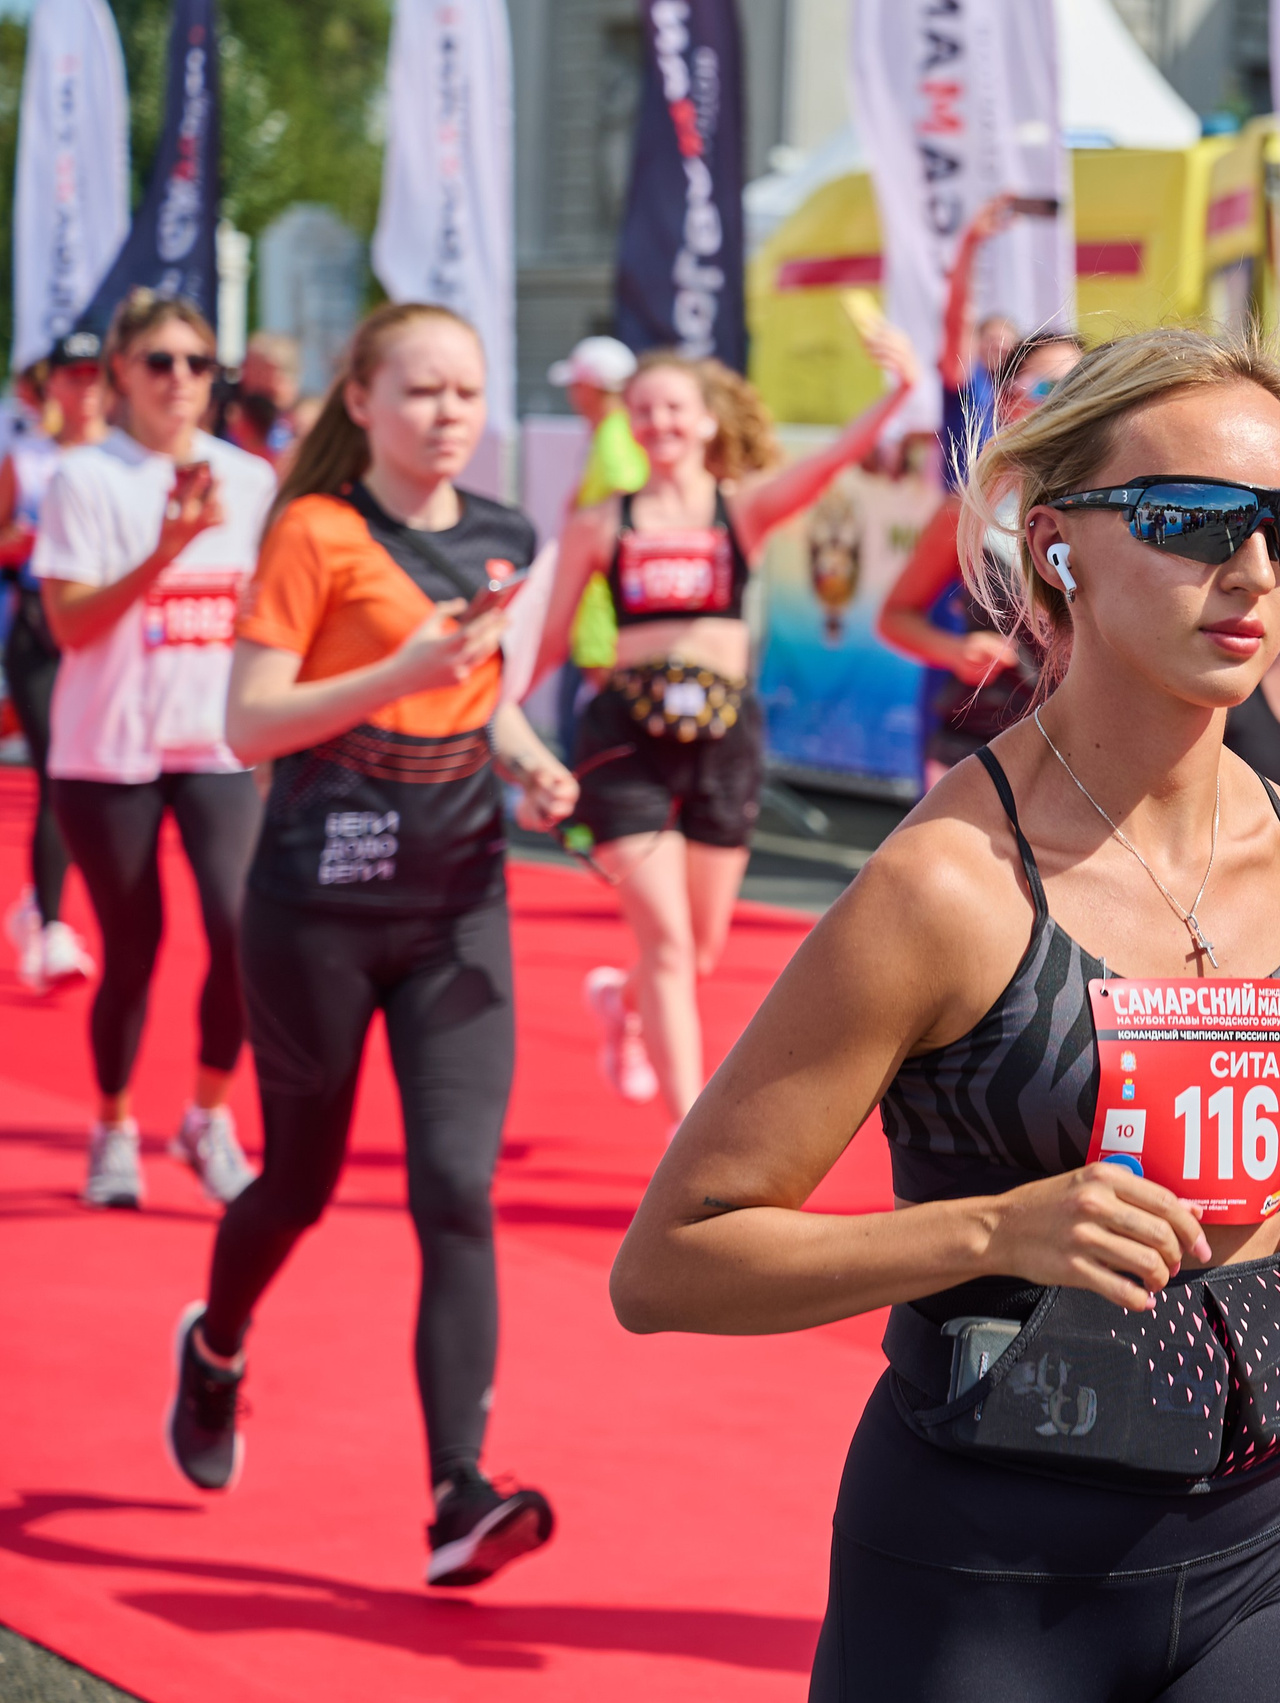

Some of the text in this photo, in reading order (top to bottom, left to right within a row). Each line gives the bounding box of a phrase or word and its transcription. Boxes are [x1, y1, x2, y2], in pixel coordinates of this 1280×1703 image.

[1113, 982, 1256, 1016] САМАРСКИЙ
[1117, 1016, 1131, 1025] НА
[1134, 1016, 1166, 1025] КУБОК
[1168, 1016, 1200, 1026] ГЛАВЫ
[1202, 1016, 1259, 1027] ГОРОДСКОГО
[1118, 1029, 1179, 1042] КОМАНДНЫЙ
[1180, 1031, 1235, 1042] ЧЕМПИОНАТ
[1235, 1031, 1268, 1042] РОССИИ
[1269, 1031, 1280, 1042] ПО
[1210, 1051, 1280, 1078] СИТА
[1116, 1124, 1134, 1138] 10
